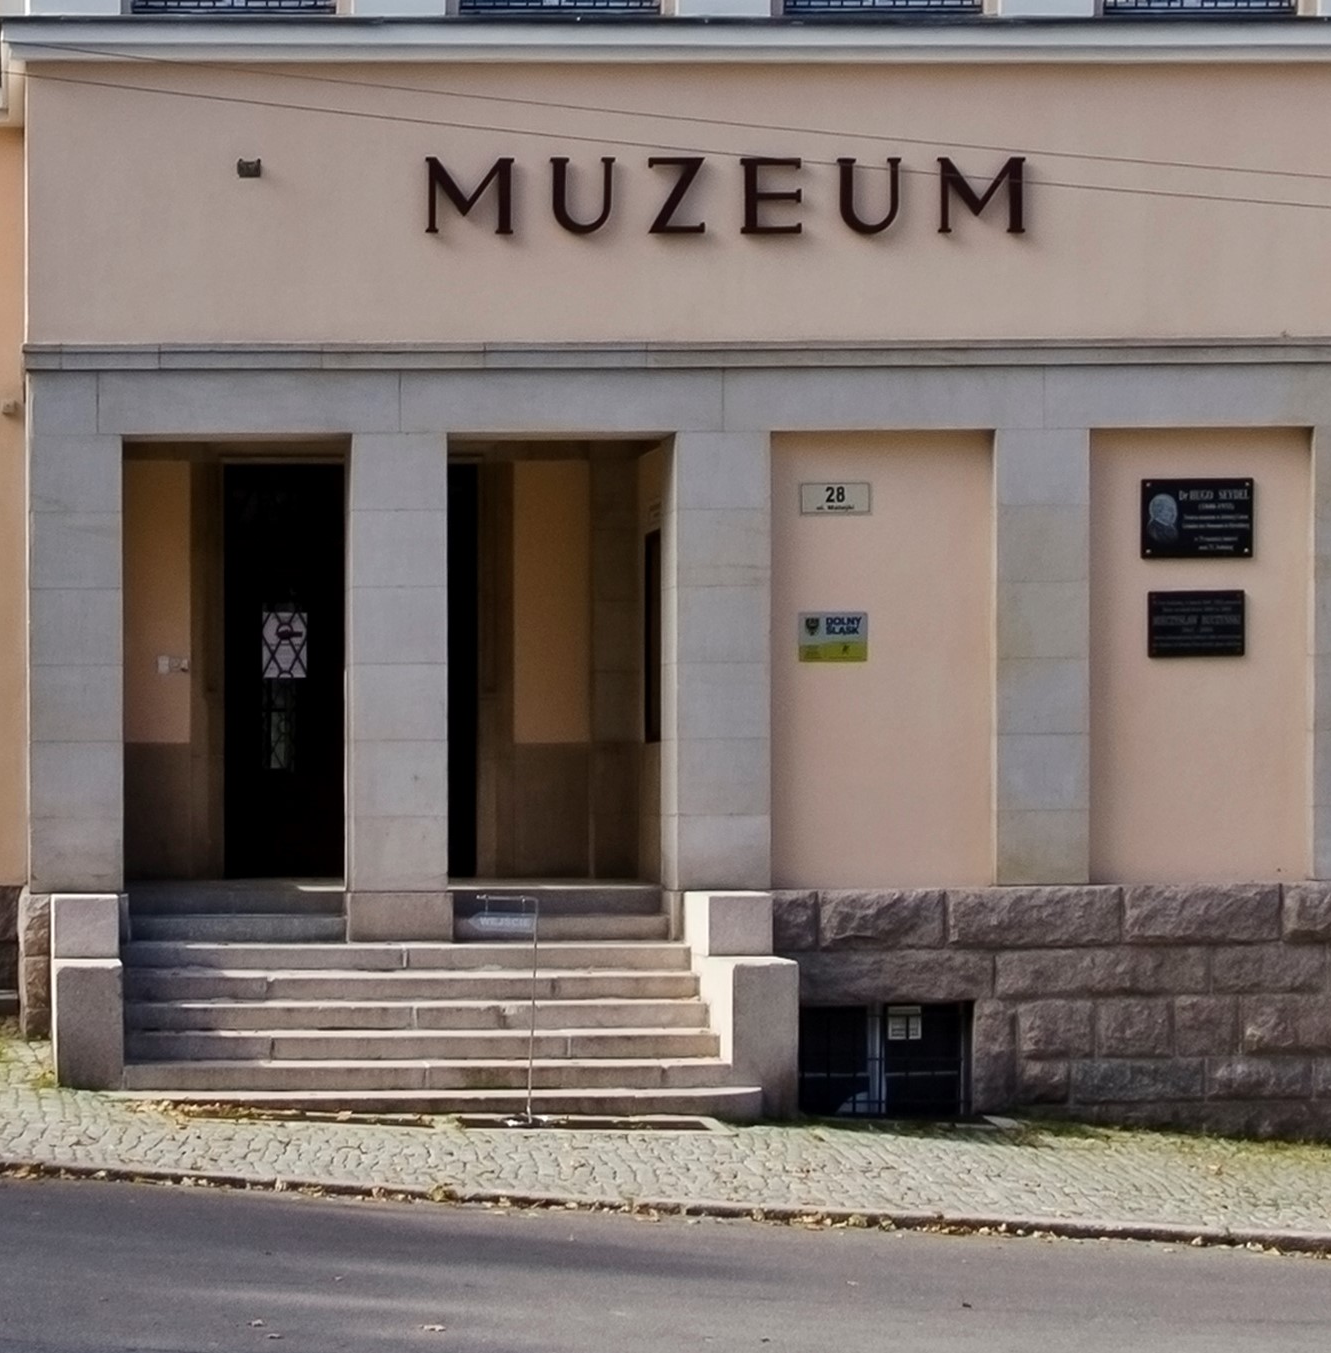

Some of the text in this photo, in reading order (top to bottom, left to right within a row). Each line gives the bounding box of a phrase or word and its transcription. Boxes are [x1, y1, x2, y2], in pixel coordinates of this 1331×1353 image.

[424, 156, 1027, 236] MUZEUM
[825, 486, 846, 503] 28
[825, 616, 862, 627] DOLNY
